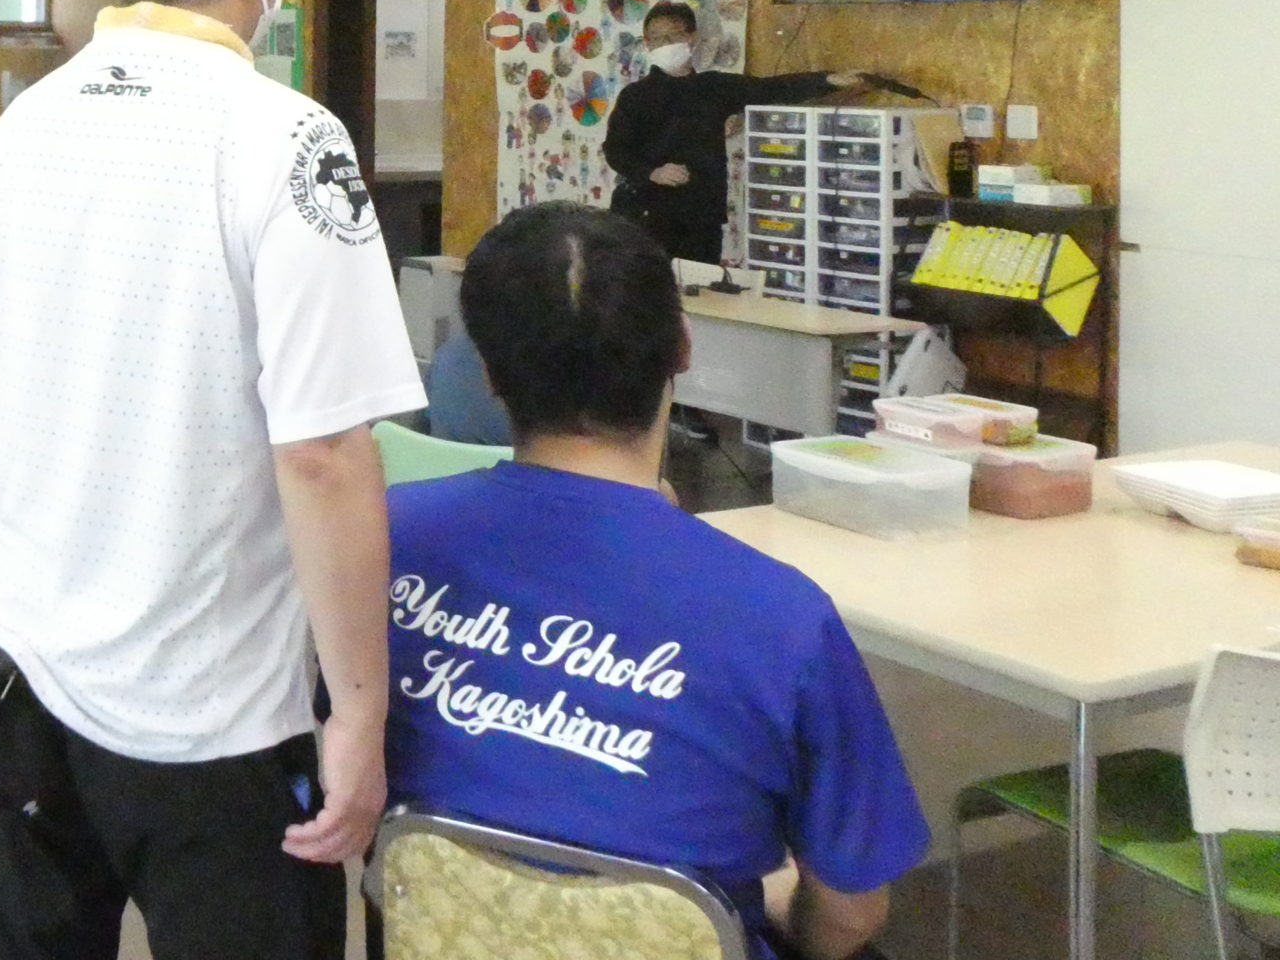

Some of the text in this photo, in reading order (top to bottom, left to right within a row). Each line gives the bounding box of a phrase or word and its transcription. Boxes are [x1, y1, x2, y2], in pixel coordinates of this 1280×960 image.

[314, 218, 333, 240] VAI
[390, 574, 686, 699] Youth Schola
[400, 650, 653, 777] Kagoshima
